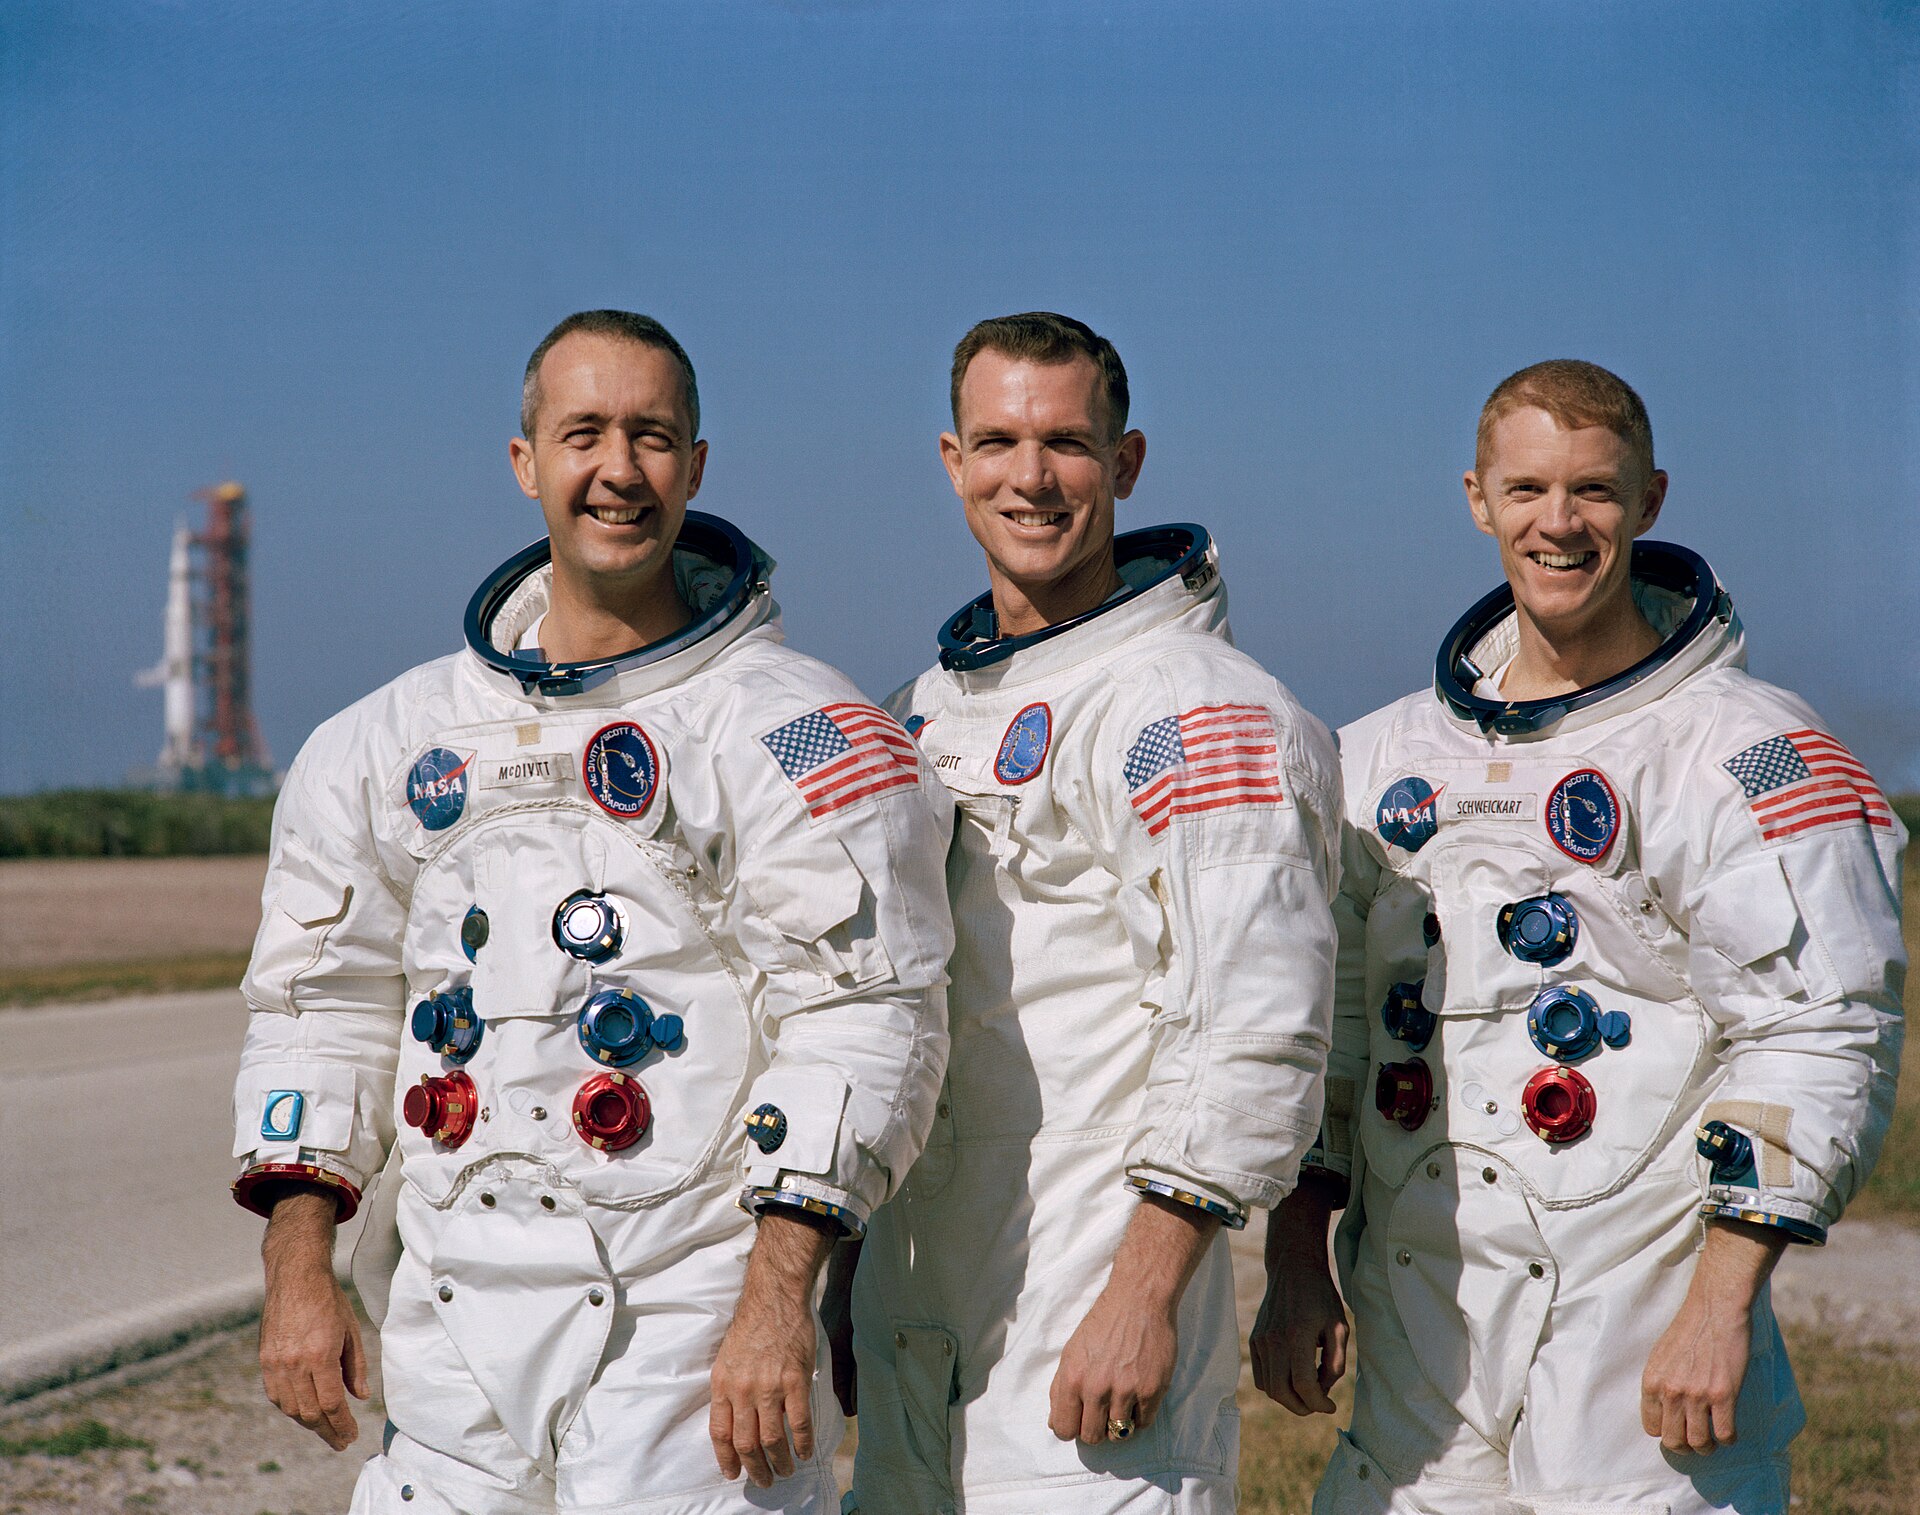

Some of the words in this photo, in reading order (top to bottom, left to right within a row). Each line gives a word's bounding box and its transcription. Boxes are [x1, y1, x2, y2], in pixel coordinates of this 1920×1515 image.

[588, 743, 601, 787] McDIVITT
[602, 727, 629, 741] SCOTT
[413, 777, 465, 800] NASA
[1565, 774, 1590, 788] SCOTT
[606, 798, 637, 812] APOLLO
[1457, 800, 1522, 814] SCHWEICKART
[1382, 806, 1434, 824] NASA
